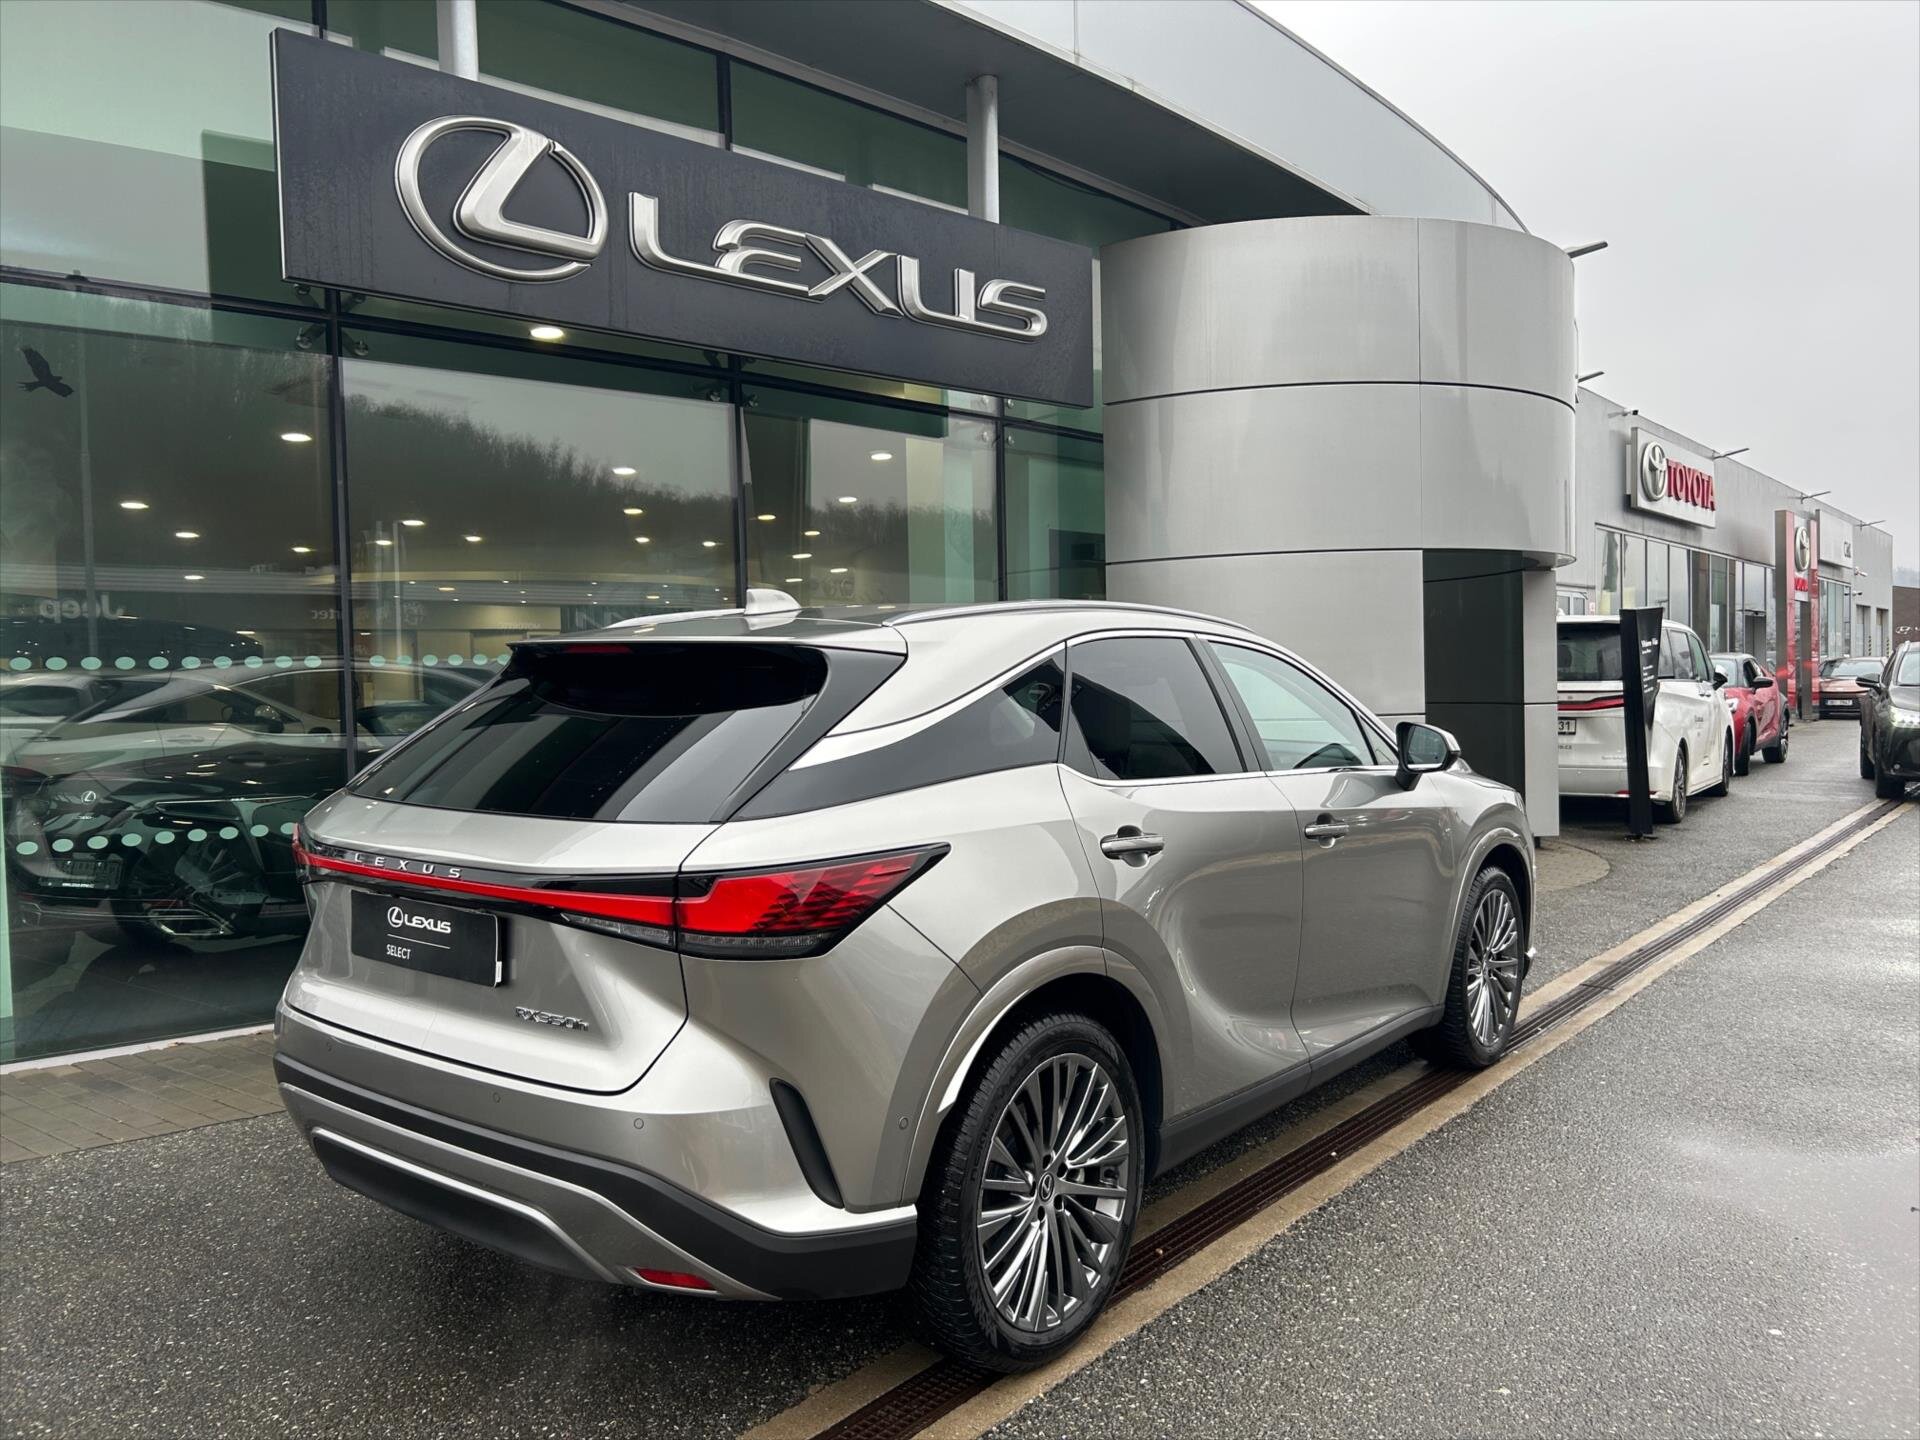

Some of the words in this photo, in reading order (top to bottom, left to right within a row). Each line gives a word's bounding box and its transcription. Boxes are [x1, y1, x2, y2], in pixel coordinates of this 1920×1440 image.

[628, 191, 1048, 343] LEXUS
[1665, 457, 1716, 512] TOYOTA
[354, 852, 463, 879] LEXUS
[404, 913, 452, 934] LEXUS
[386, 943, 412, 960] SELECT
